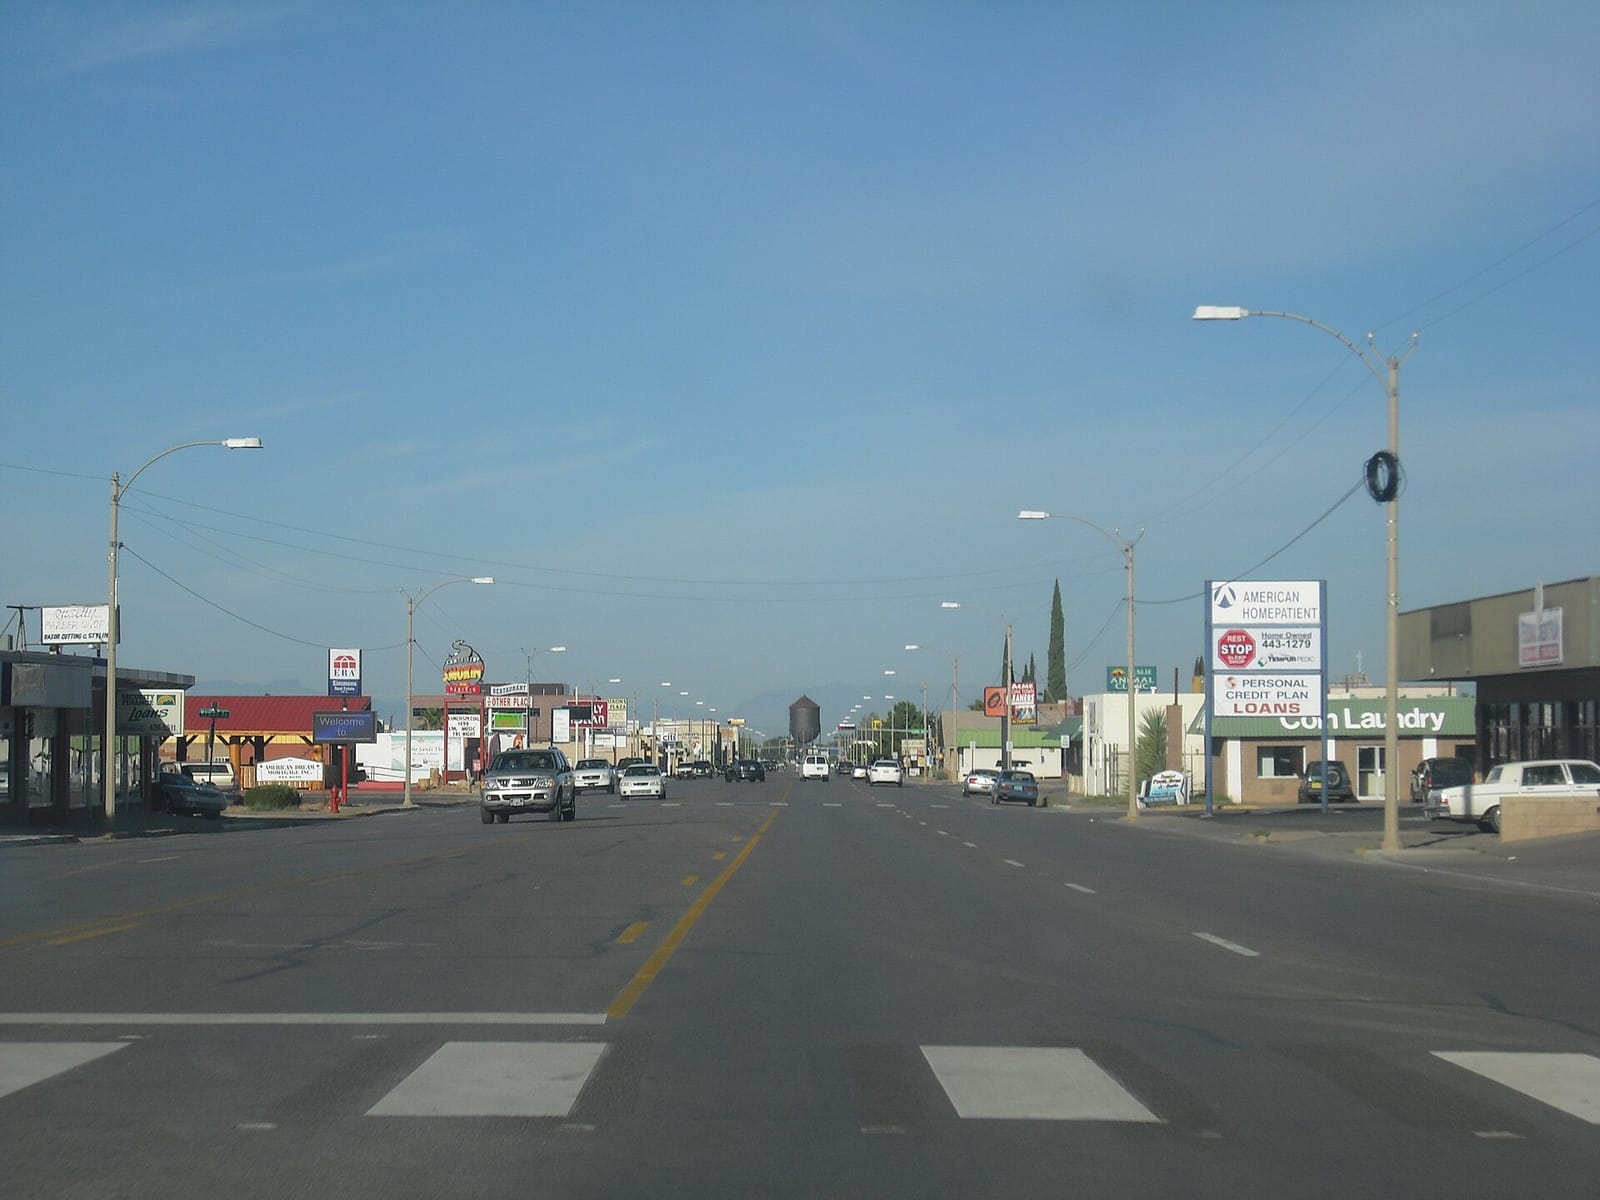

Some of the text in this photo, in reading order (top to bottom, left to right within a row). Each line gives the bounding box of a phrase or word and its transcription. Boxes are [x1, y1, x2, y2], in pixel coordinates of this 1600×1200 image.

[1243, 591, 1300, 603] AMERICAN
[1243, 607, 1318, 619] HOMEPATIENT
[1261, 632, 1312, 640] Home Owned
[1262, 640, 1311, 649] 443-1279
[1221, 645, 1252, 655] STOP
[334, 669, 355, 677] ERA
[1242, 679, 1308, 688] PERSONAL
[492, 685, 526, 694] RESTAURANT
[1226, 691, 1309, 700] CREDIT PLAN
[492, 697, 511, 706] OTHER
[1233, 703, 1301, 714] LOANS
[128, 707, 169, 722] Loans
[319, 717, 365, 726] Welcome
[337, 728, 347, 736] to
[662, 733, 677, 742] citi
